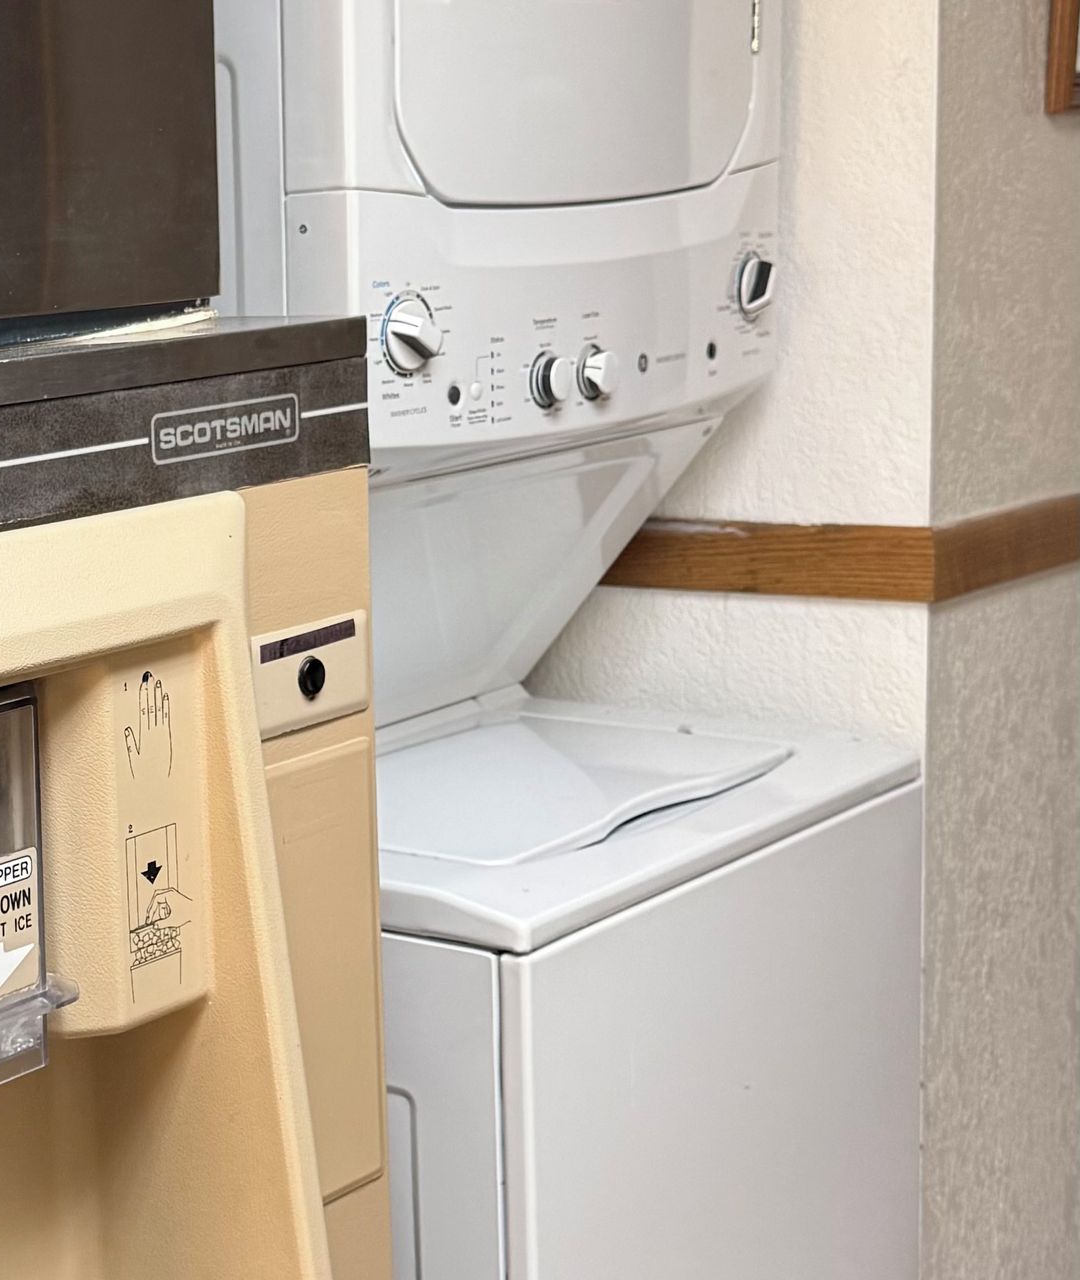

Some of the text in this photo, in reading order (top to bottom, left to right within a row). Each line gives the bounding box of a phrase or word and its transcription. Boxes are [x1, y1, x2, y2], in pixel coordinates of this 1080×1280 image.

[159, 407, 292, 450] SCOTSMAN
[127, 824, 134, 834] 2
[14, 913, 33, 933] ICE
